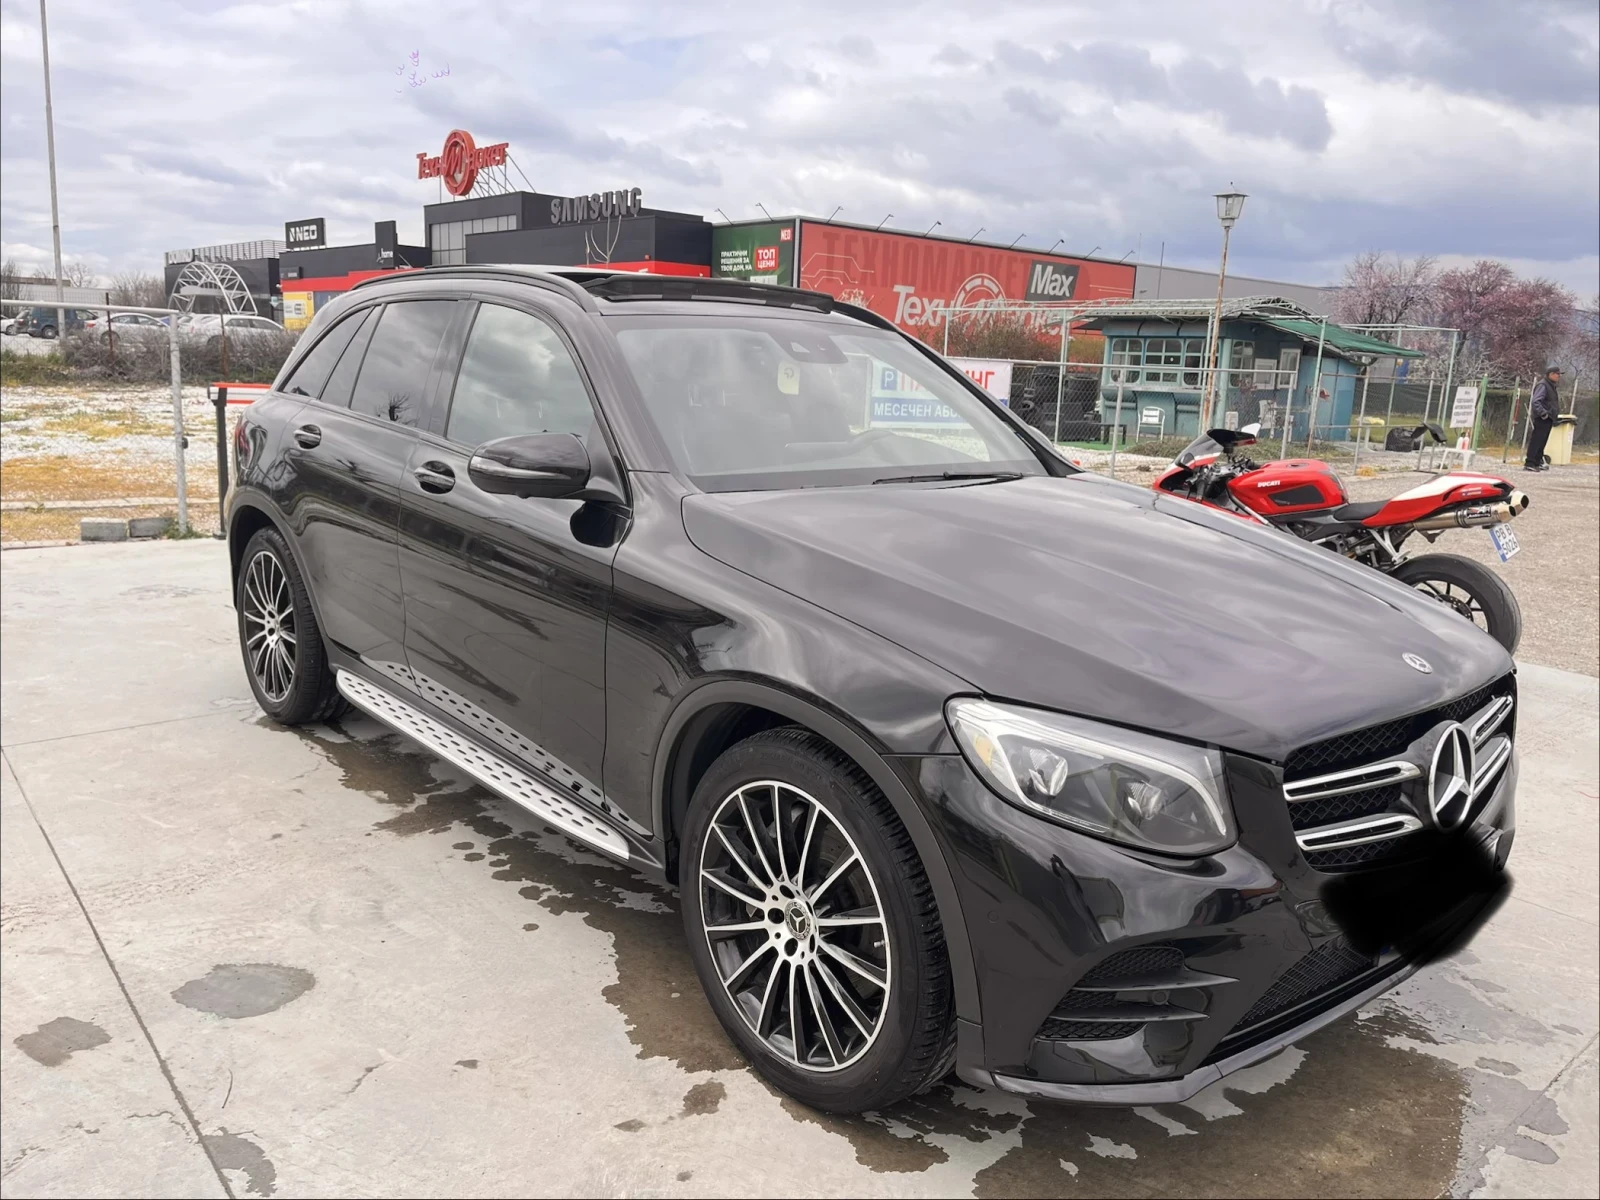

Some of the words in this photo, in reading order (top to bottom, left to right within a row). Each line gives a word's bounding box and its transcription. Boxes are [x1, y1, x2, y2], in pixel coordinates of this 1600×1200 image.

[551, 187, 642, 224] SAMSUNG
[296, 224, 318, 241] NEO
[780, 229, 791, 240] NEO
[758, 249, 776, 260] ТОП
[757, 260, 775, 269] ЦЕНИ
[1030, 264, 1074, 297] Max
[874, 403, 932, 417] МЕСЕЧЕН
